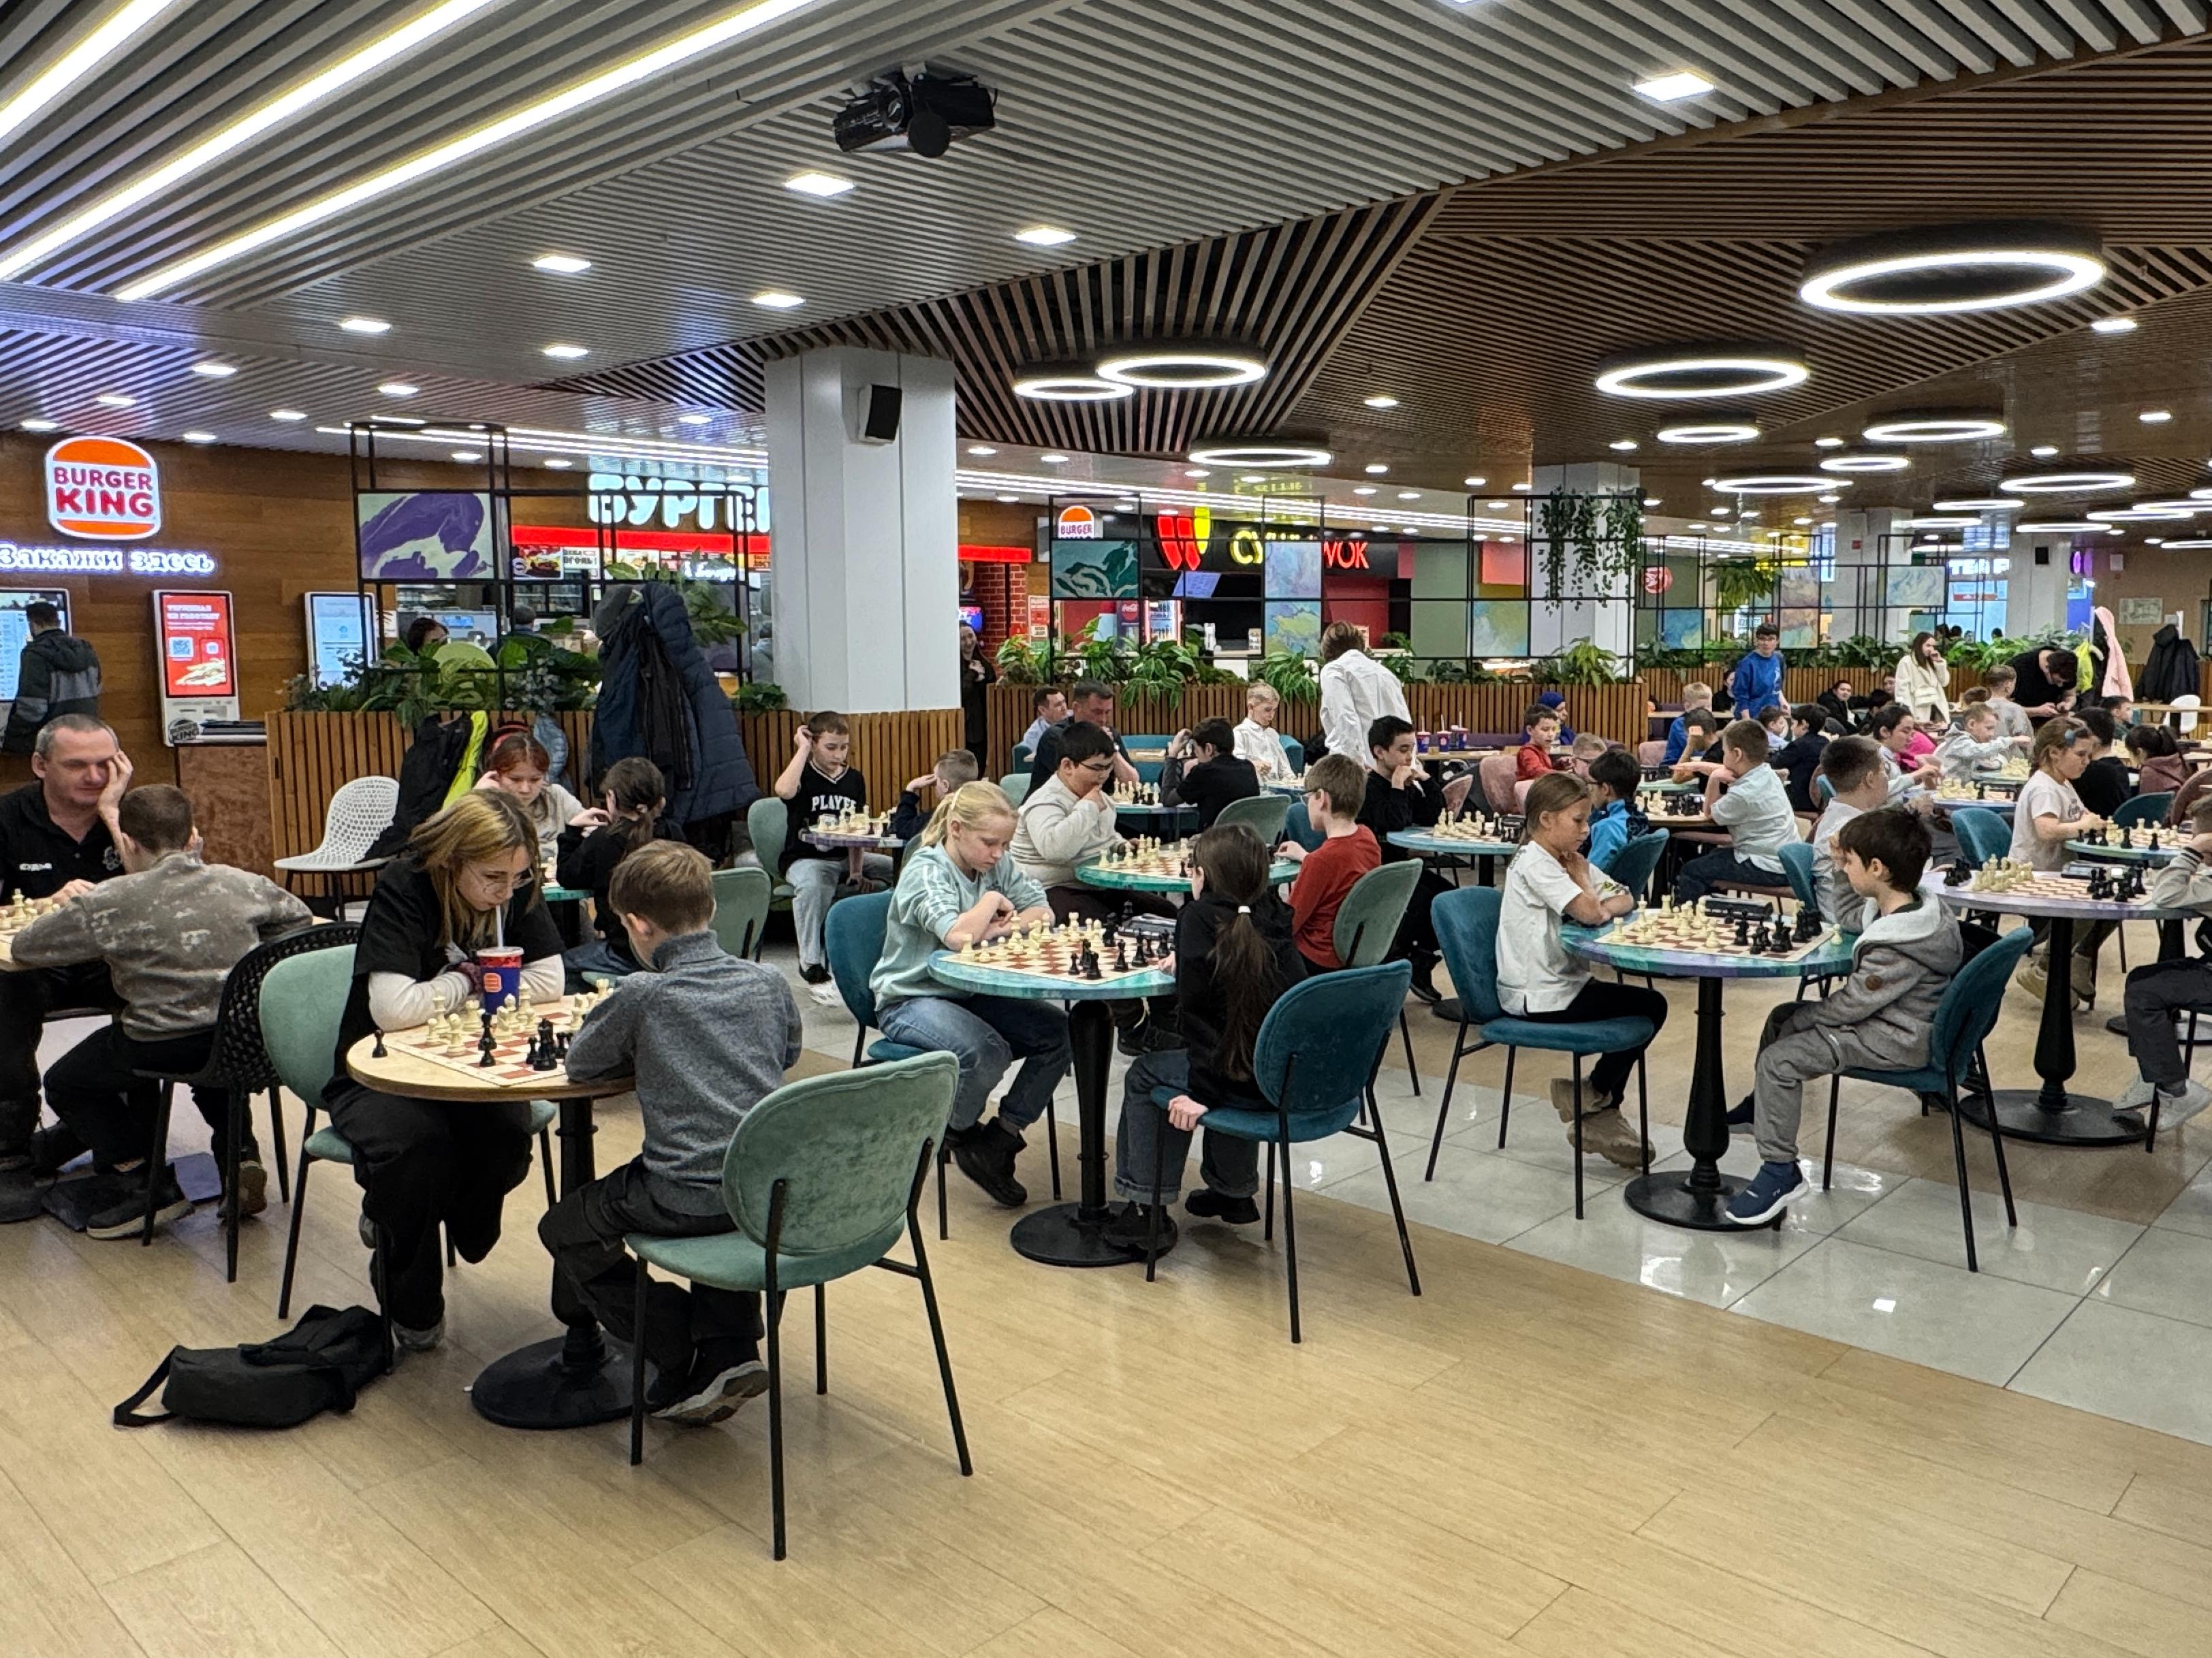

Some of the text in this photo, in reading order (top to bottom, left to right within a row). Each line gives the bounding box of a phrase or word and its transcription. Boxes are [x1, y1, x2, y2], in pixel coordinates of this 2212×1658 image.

[54, 466, 153, 491] BURGER
[55, 486, 154, 517] KING
[1060, 524, 1093, 535] BURGER
[0, 543, 215, 572] Закажи здесь
